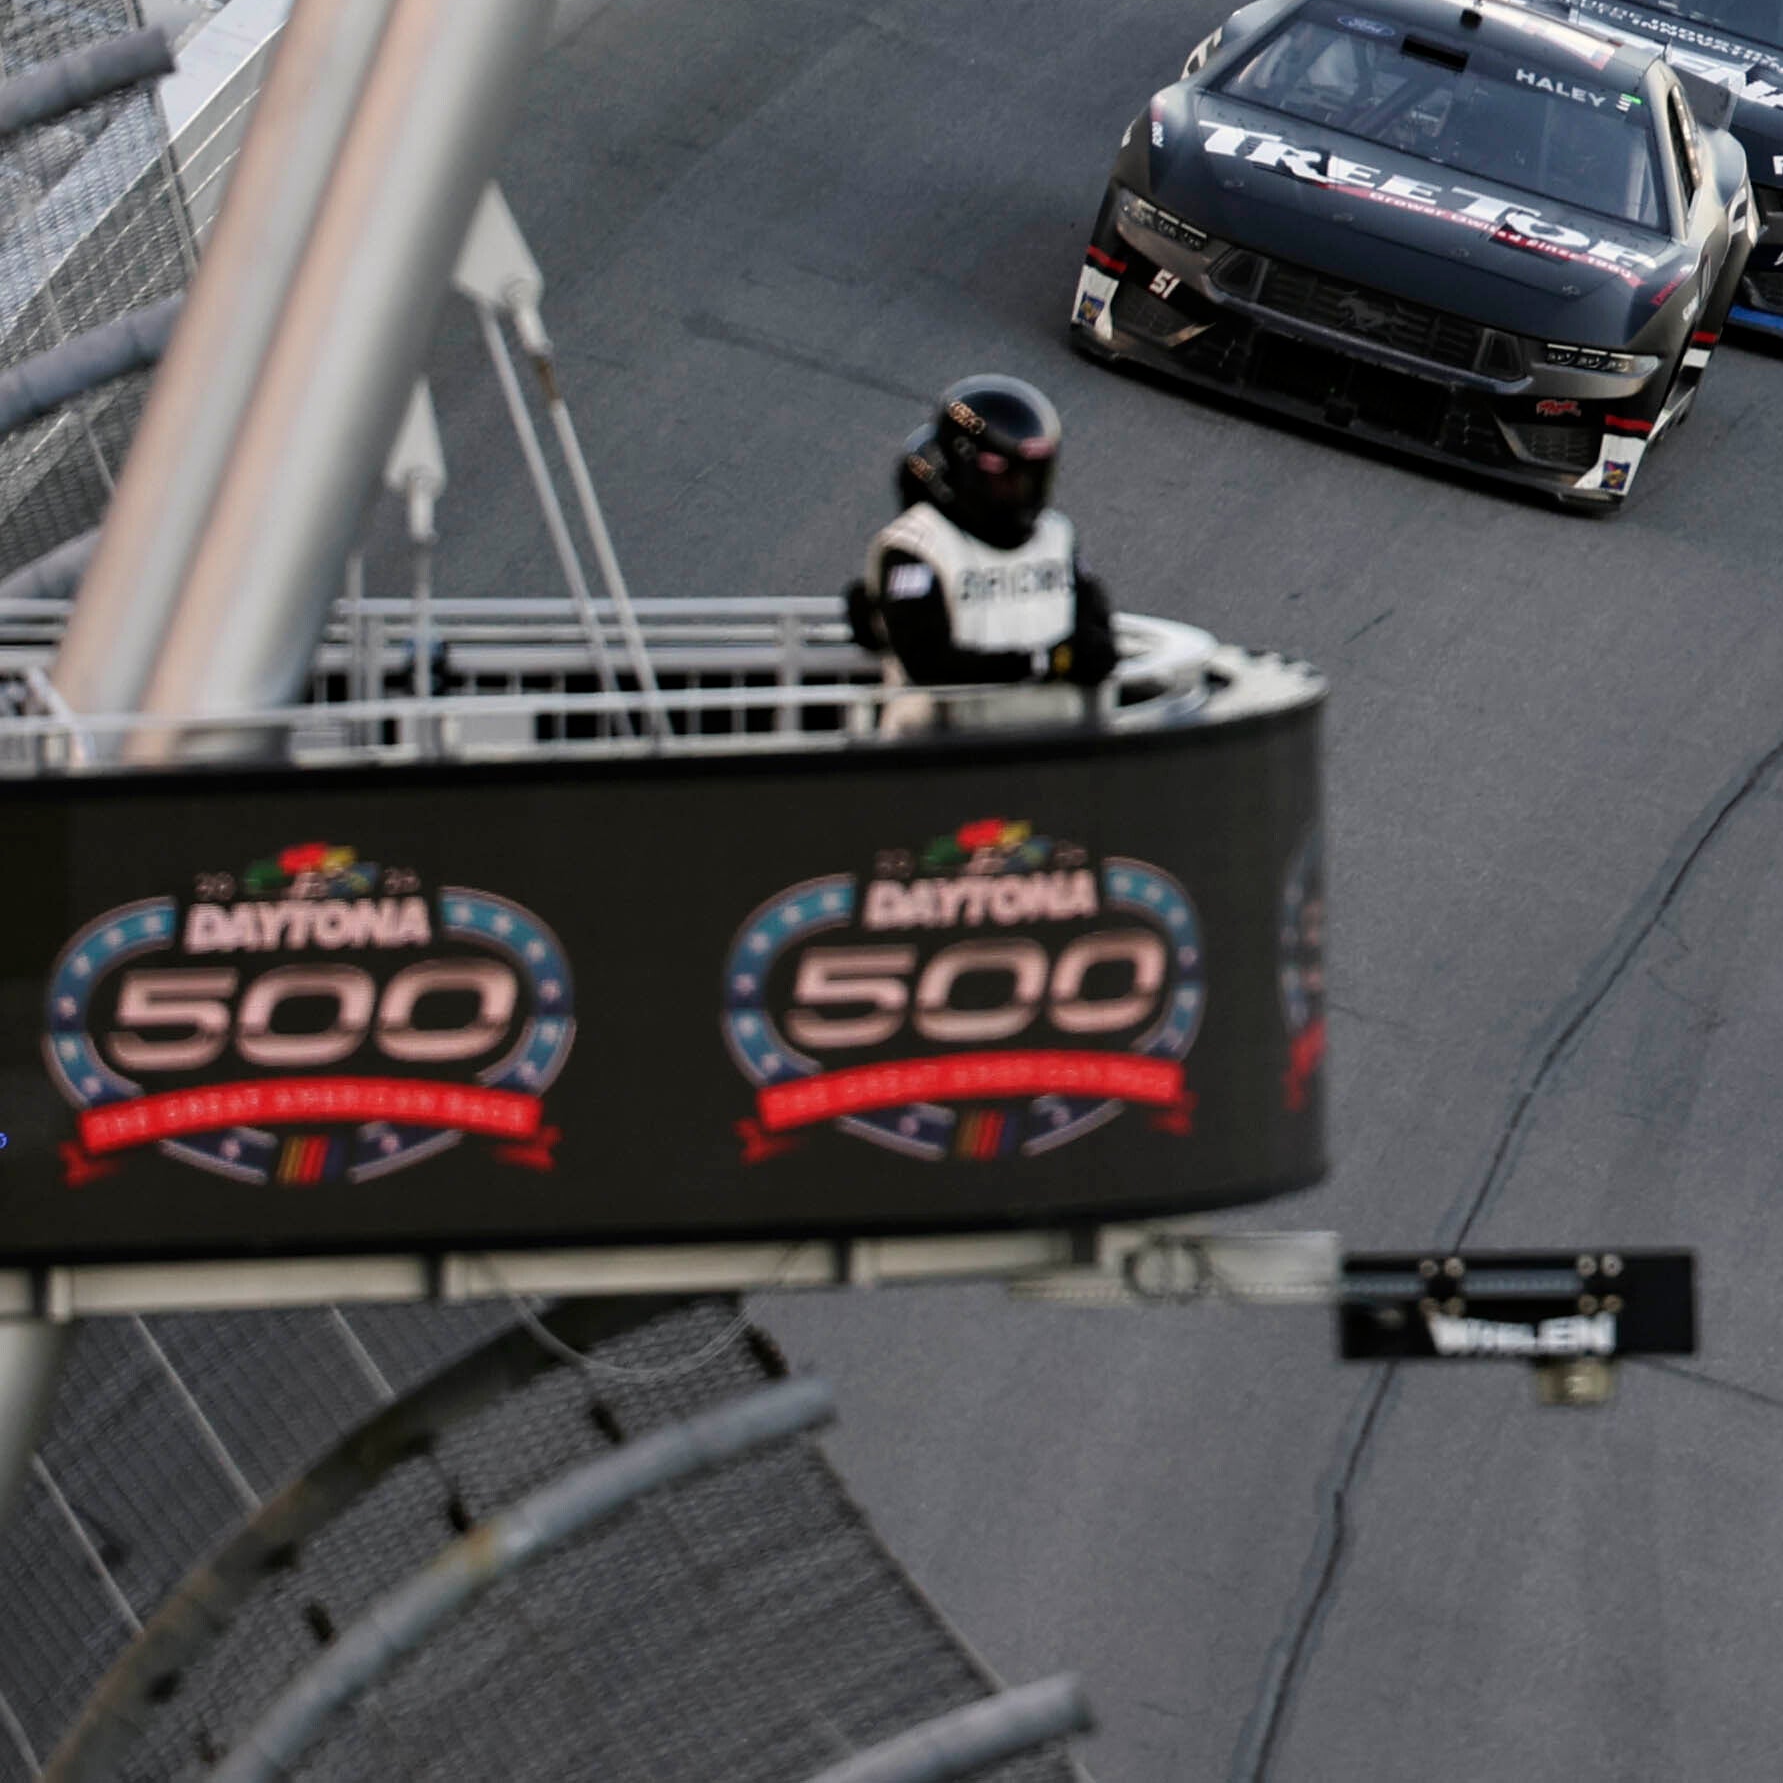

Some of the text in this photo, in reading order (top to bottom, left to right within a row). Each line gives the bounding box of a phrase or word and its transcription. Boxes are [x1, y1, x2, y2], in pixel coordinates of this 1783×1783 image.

[1515, 67, 1607, 108] HALEY
[1149, 268, 1180, 301] 51
[183, 897, 432, 955] DAYTONA
[863, 868, 1097, 931] DAYTONA
[106, 957, 519, 1071] 500
[785, 928, 1168, 1049] 500
